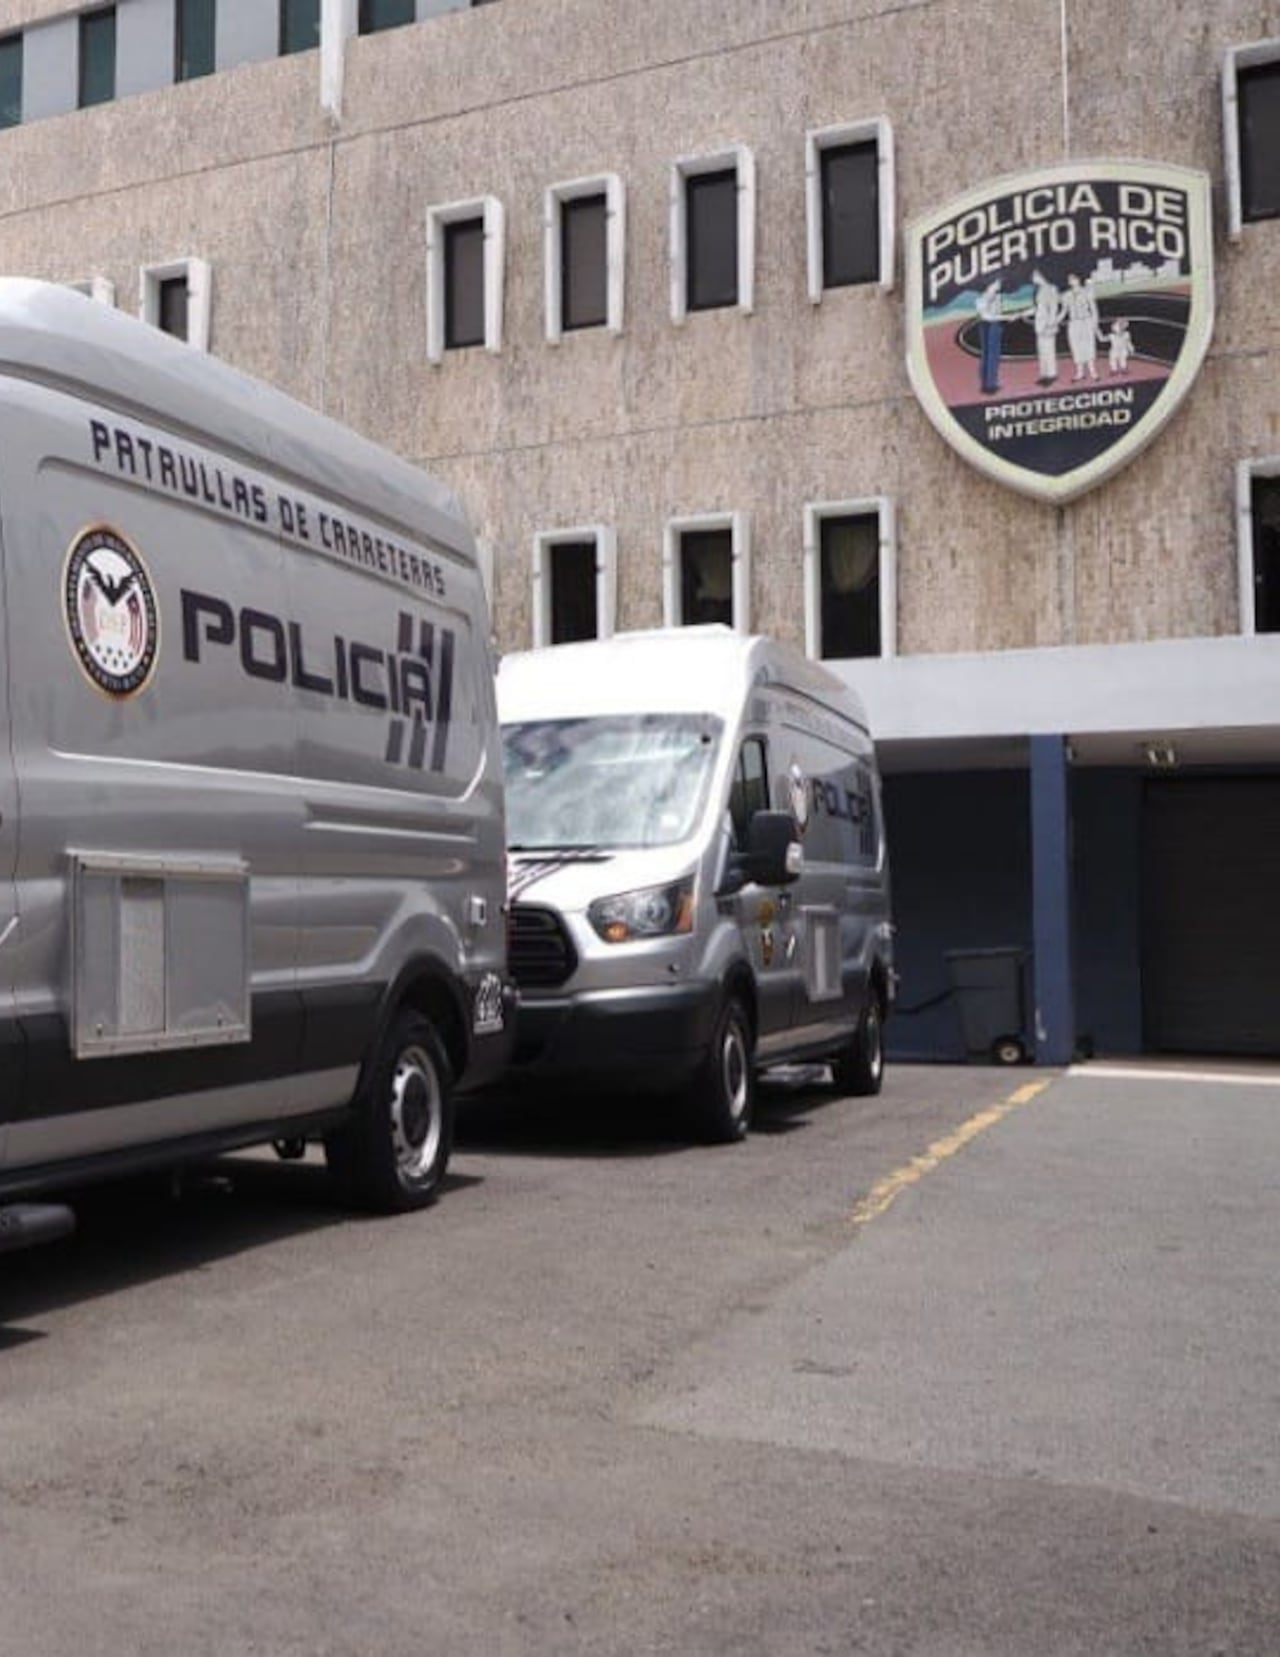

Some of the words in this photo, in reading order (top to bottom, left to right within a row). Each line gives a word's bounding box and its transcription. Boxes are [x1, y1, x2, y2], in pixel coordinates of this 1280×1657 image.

[926, 183, 1102, 265] POLICIA
[1118, 184, 1184, 225] DE
[929, 217, 1076, 302] PUERTO
[1090, 216, 1185, 260] RICO
[984, 387, 1134, 422] PROTECCION
[988, 408, 1131, 441] INTEGRIDAD
[90, 419, 268, 523] PATRULLAS
[277, 494, 310, 540] DE
[317, 511, 446, 596] CARRETERAS
[179, 587, 433, 721] POLICIA
